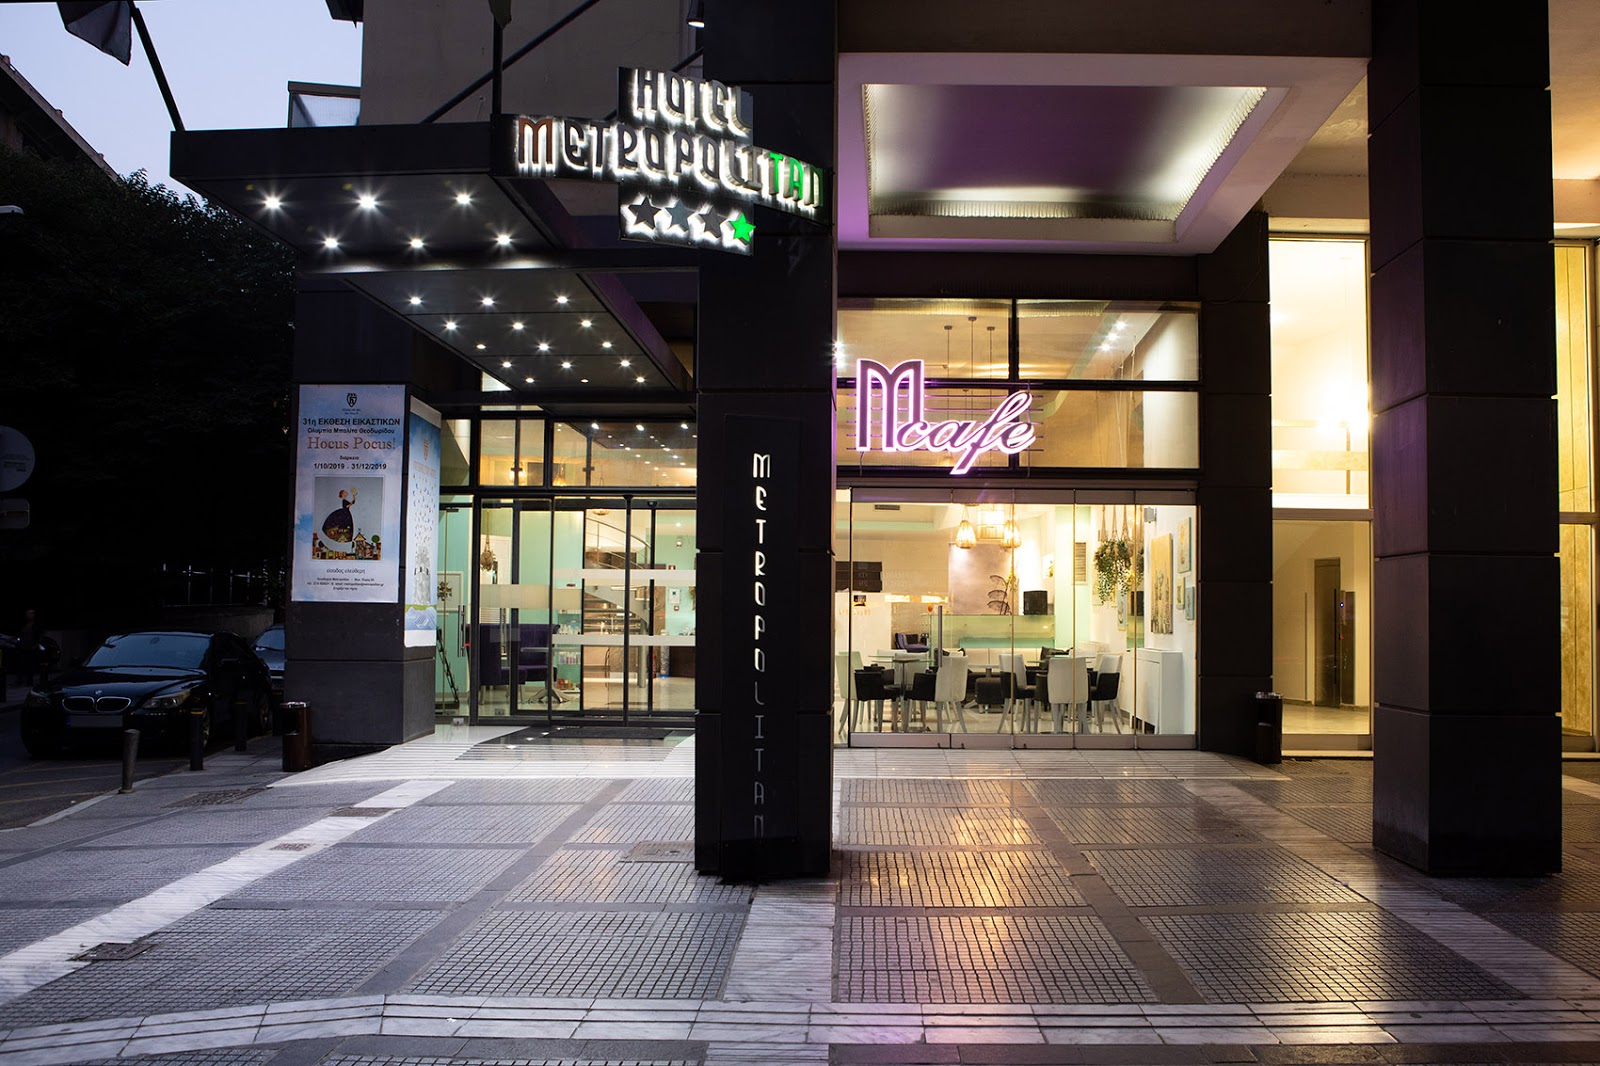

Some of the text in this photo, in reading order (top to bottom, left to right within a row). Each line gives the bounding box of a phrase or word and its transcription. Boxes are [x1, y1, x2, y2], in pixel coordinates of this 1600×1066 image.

[635, 67, 752, 135] HOTEL
[516, 116, 824, 211] METROPOLITAN
[307, 436, 397, 450] Hocus Pocus!
[318, 418, 351, 426] ΕΚΘΕΣΗ
[352, 418, 400, 426] ΕΙΚΑΣΤΙΚΩΝ
[752, 452, 772, 839] METROPOLITAN
